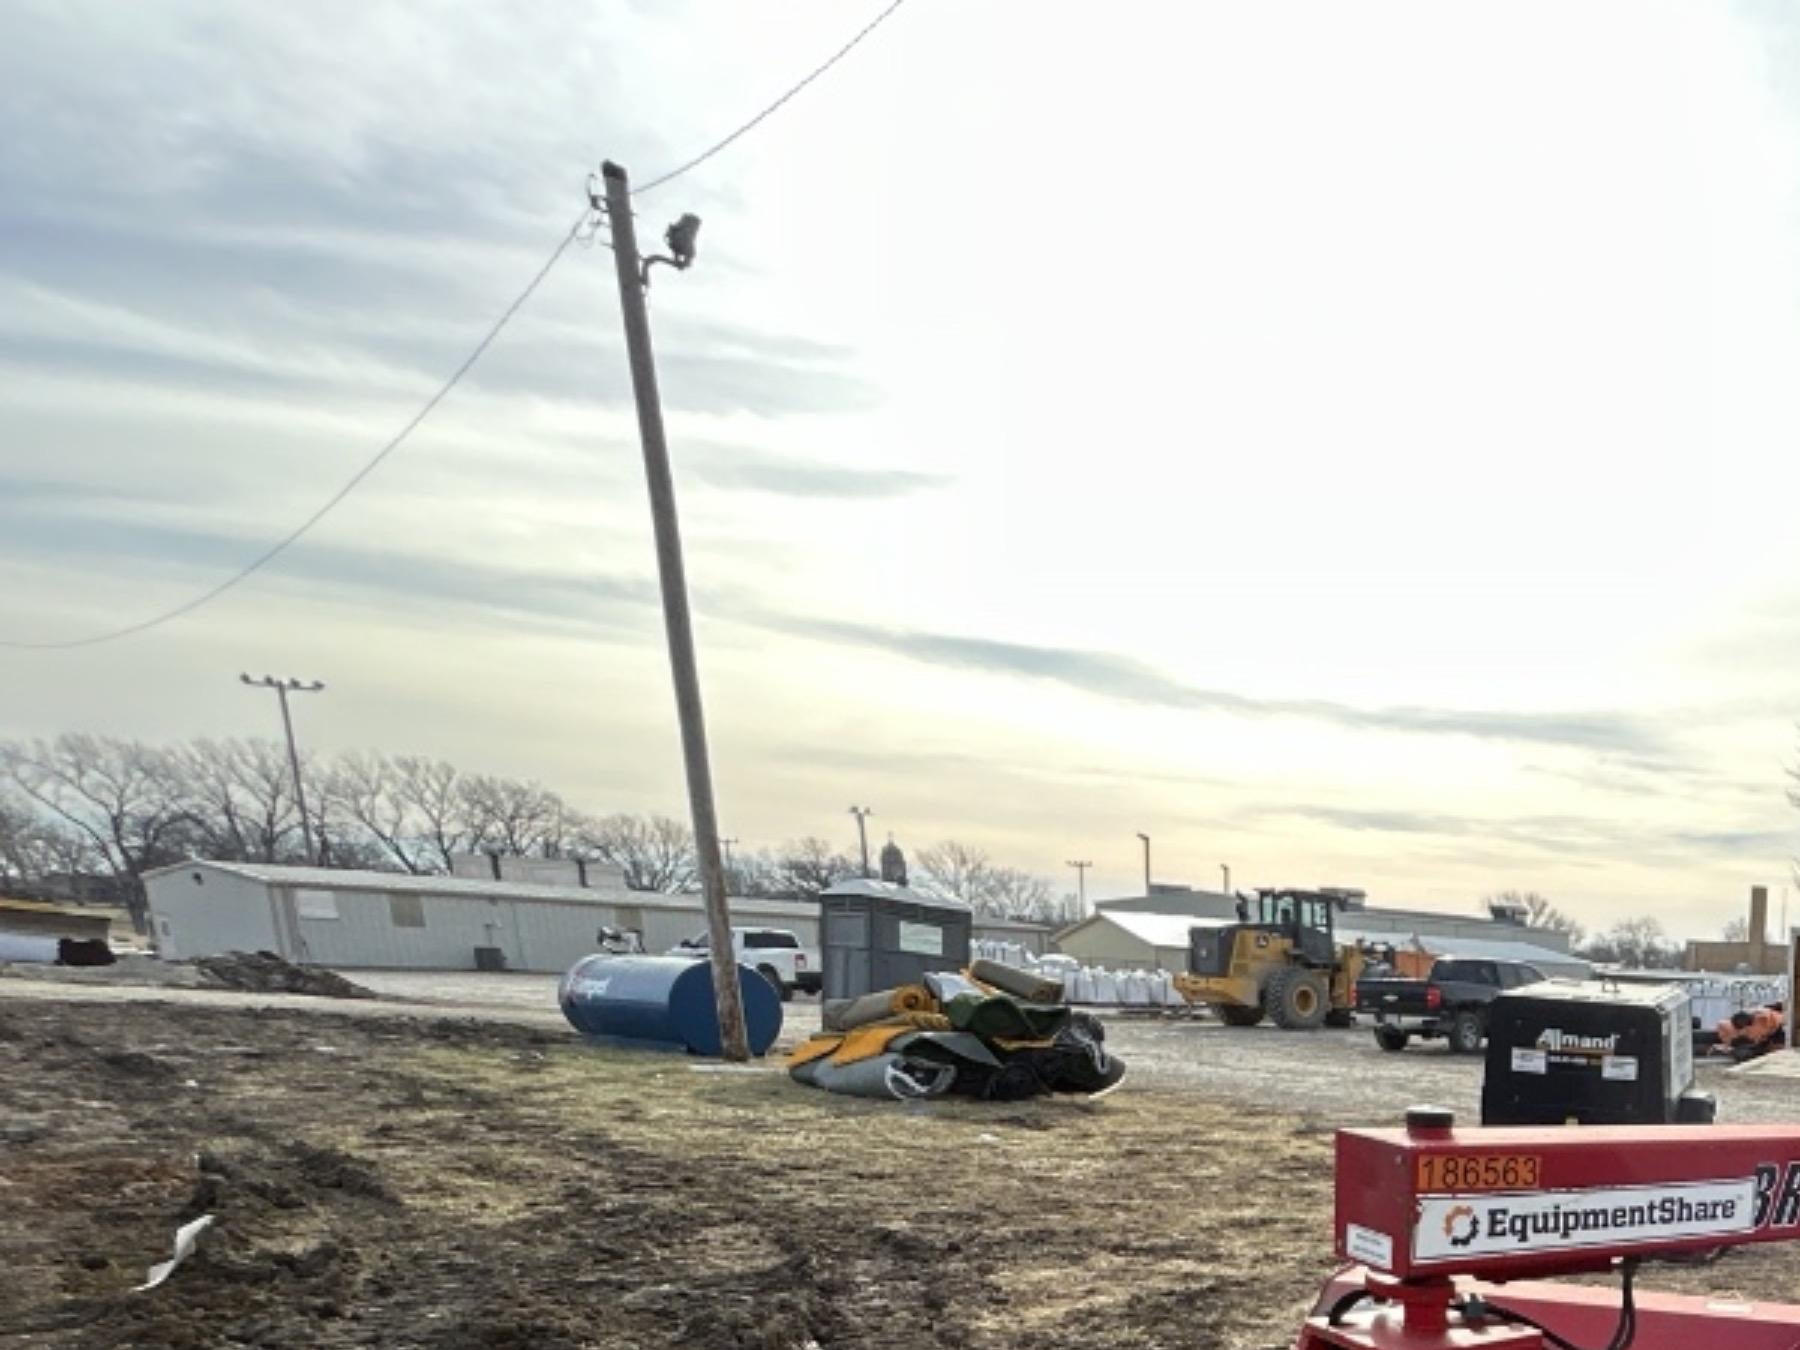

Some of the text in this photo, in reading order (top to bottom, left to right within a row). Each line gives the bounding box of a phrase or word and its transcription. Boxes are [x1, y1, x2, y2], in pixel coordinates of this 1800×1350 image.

[1535, 1027, 1616, 1051] Allmand
[1422, 1157, 1538, 1188] 186563
[1487, 1197, 1736, 1243] EquipmentShare
